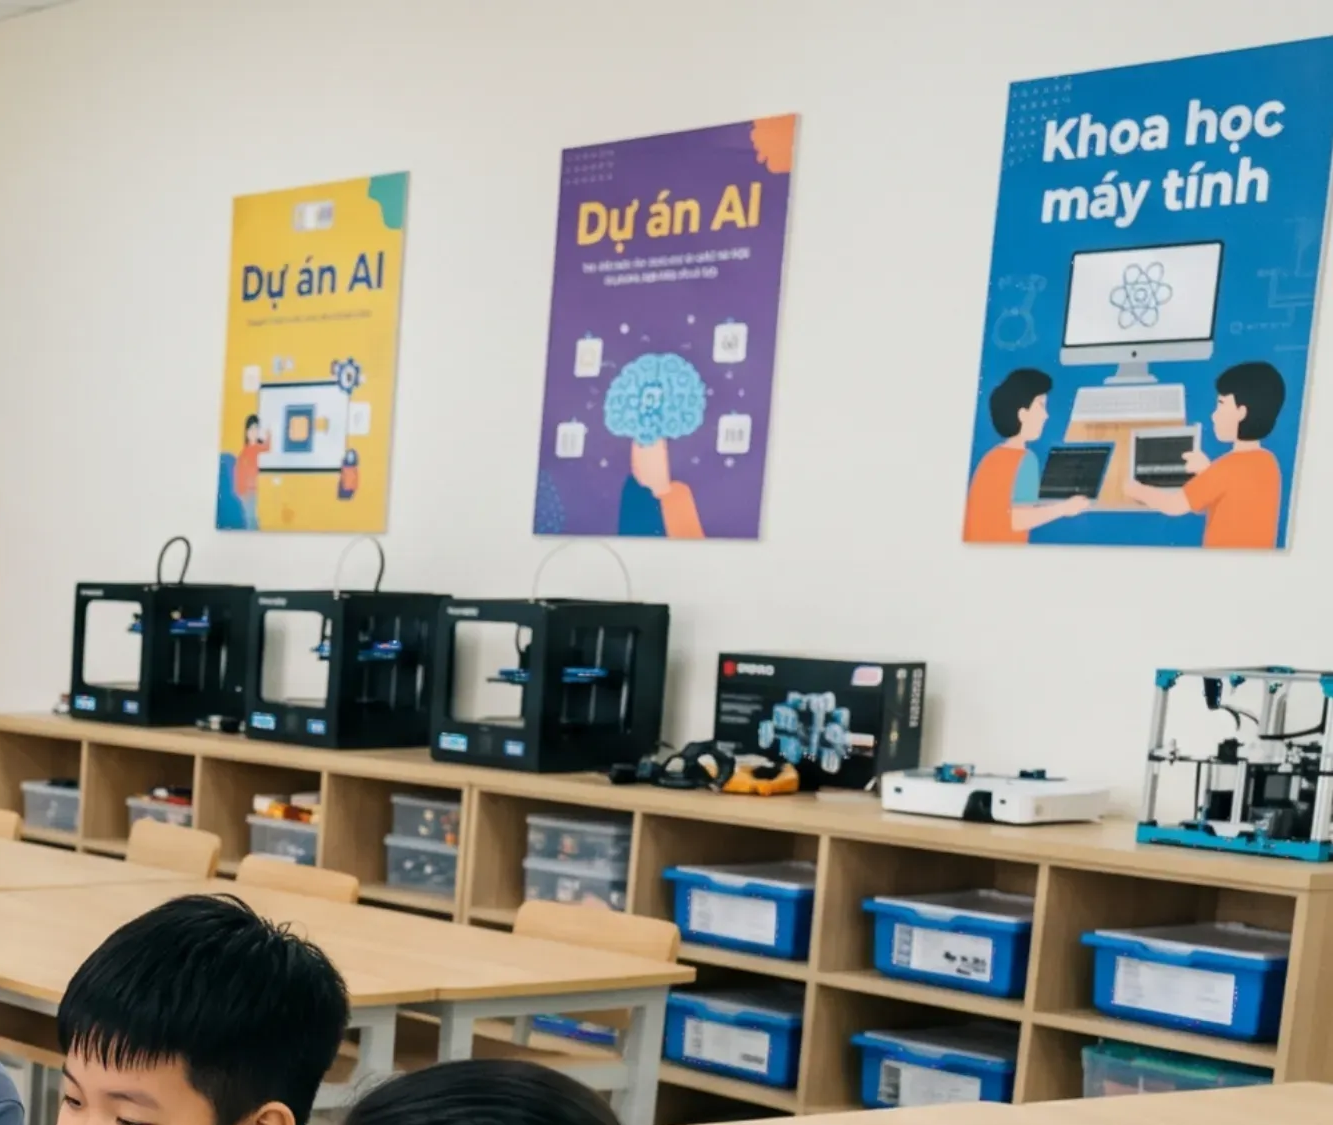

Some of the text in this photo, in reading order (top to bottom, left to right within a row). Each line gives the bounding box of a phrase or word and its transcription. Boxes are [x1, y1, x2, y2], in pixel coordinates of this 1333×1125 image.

[1042, 99, 1286, 162] Khoa học
[577, 182, 761, 254] Dự án AI
[1041, 157, 1269, 228] máy tính
[242, 251, 384, 310] Dự án AI
